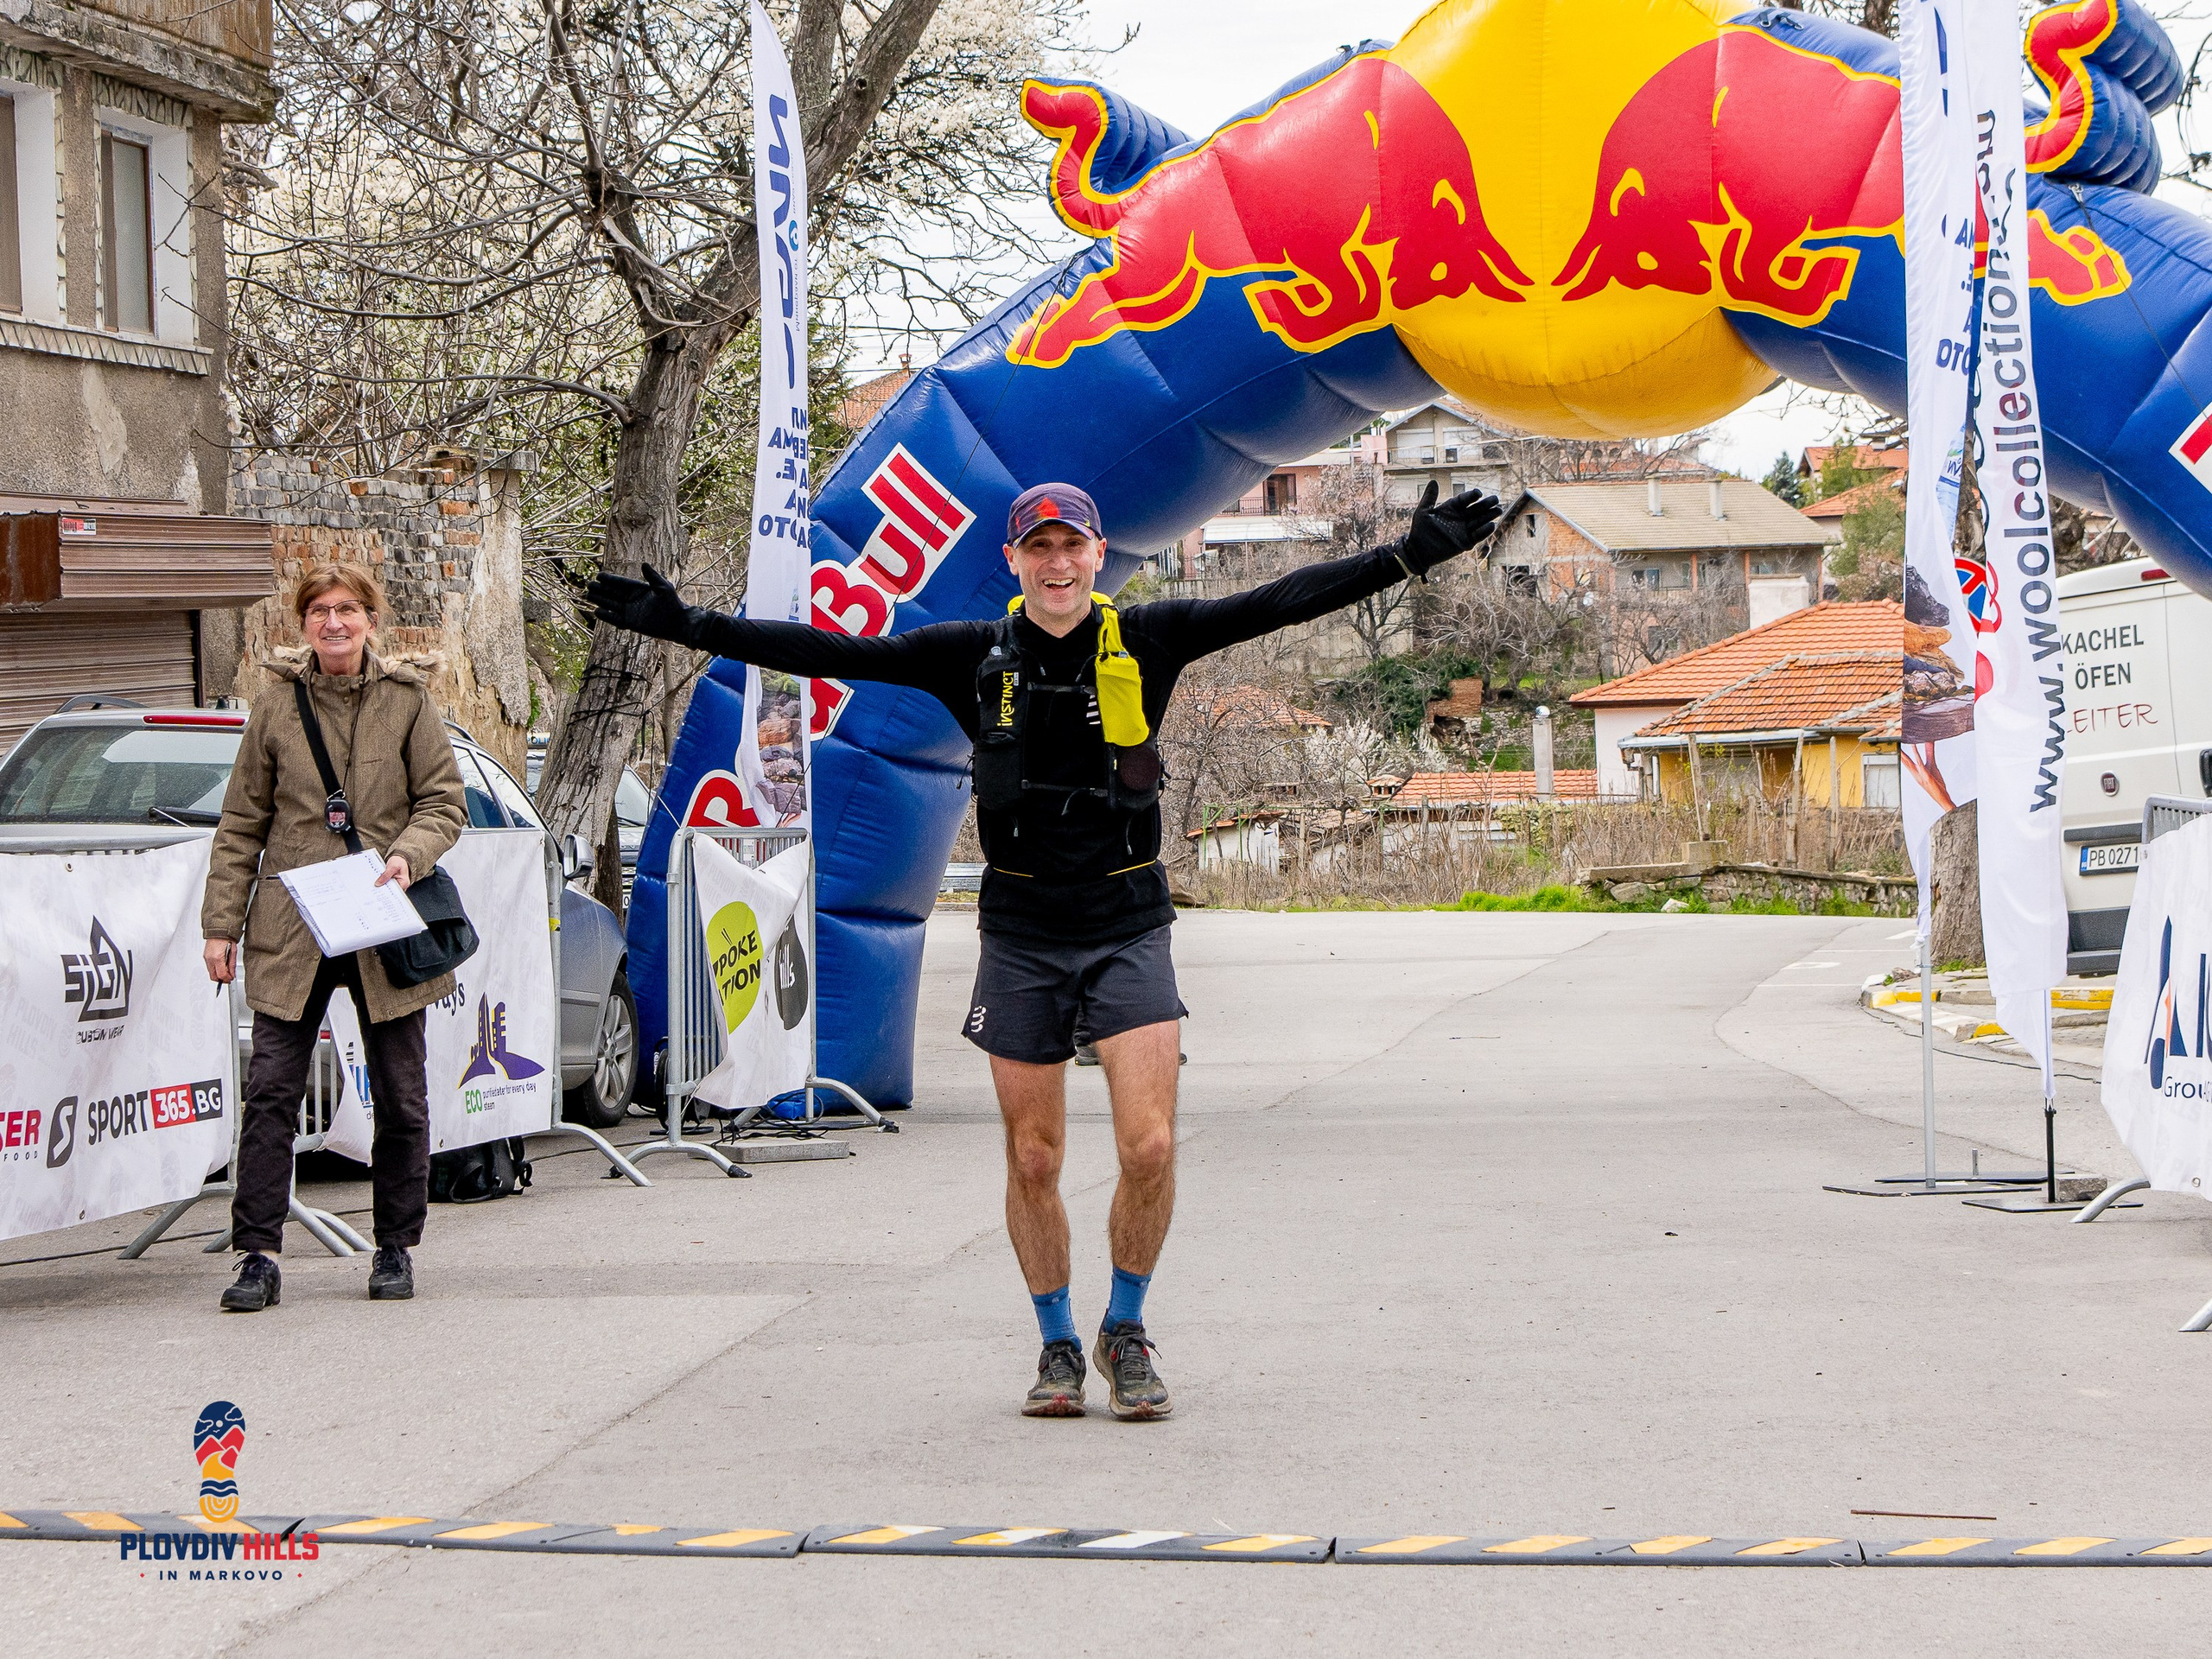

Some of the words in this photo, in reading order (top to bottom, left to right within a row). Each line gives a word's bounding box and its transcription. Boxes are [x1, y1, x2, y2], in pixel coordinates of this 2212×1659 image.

[810, 452, 966, 637] Bull
[2062, 625, 2145, 655] KACHEL
[2075, 662, 2132, 690] ÖFEN
[2067, 703, 2158, 734] EITER
[2089, 849, 2106, 868] PB
[2108, 846, 2139, 865] 0271
[525, 1081, 537, 1093] day
[465, 1089, 483, 1114] ECO
